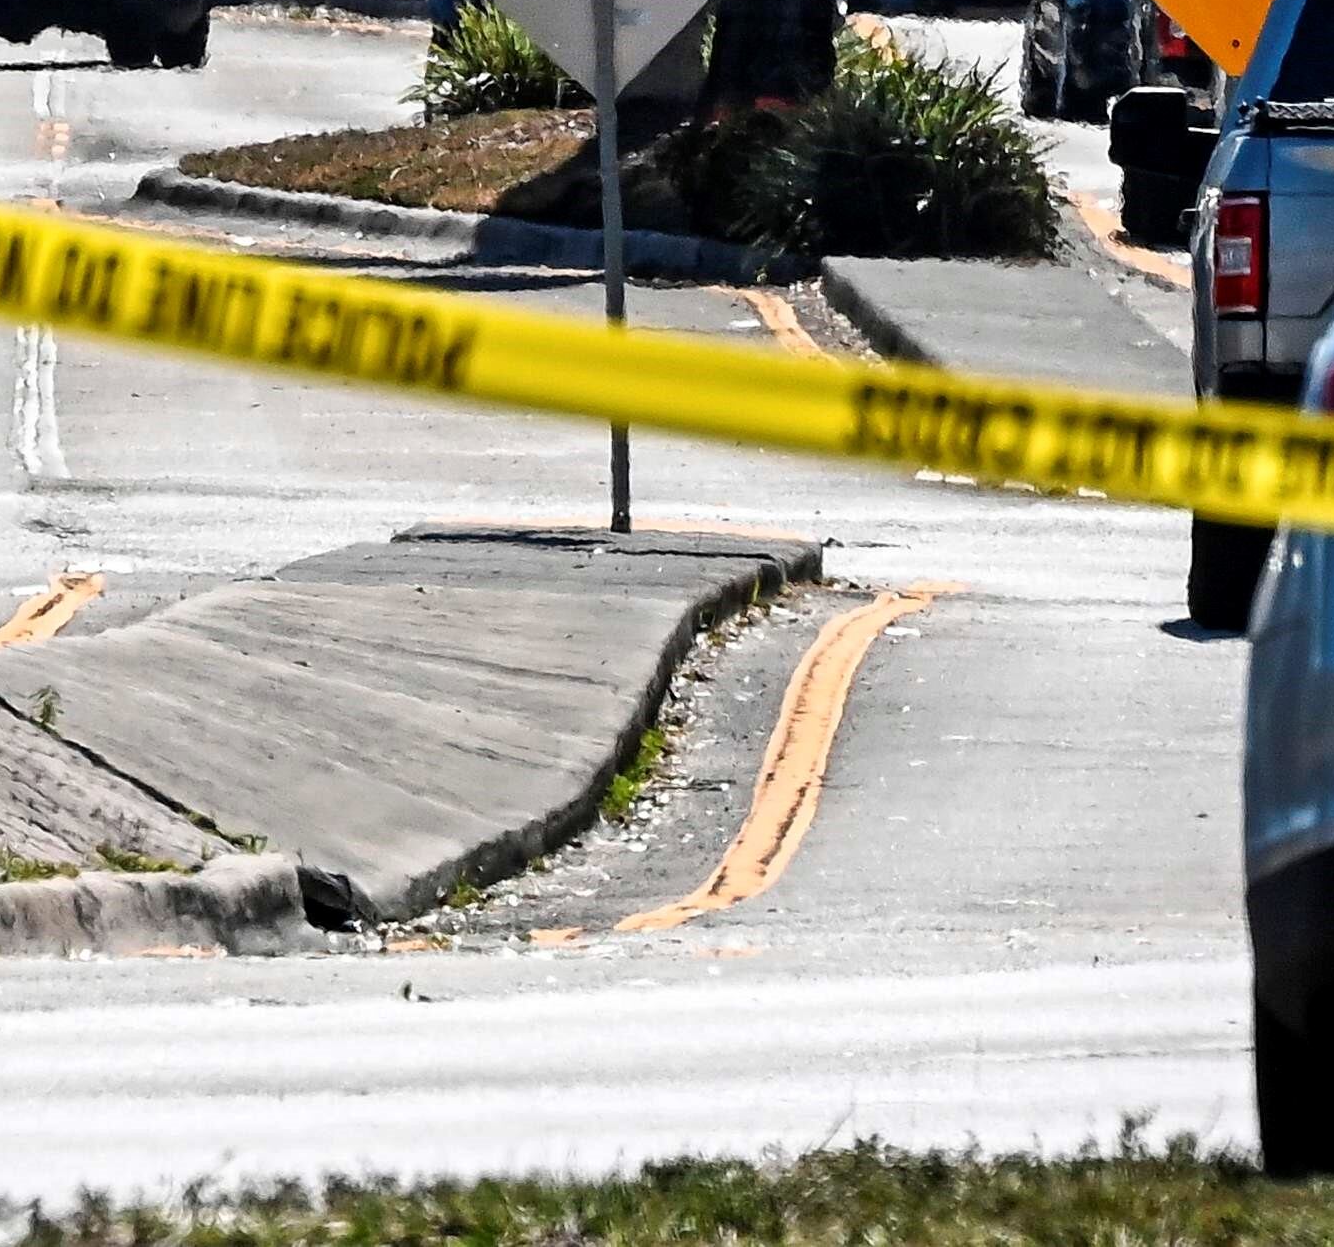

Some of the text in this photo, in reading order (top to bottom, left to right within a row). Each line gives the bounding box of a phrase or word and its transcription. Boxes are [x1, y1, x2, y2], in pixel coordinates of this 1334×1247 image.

[55, 239, 126, 328] DO
[133, 256, 259, 354] LINE
[279, 283, 474, 387] POLICE
[855, 381, 1031, 469] CROSS
[1057, 406, 1155, 483] NOT
[1185, 421, 1254, 493] DO
